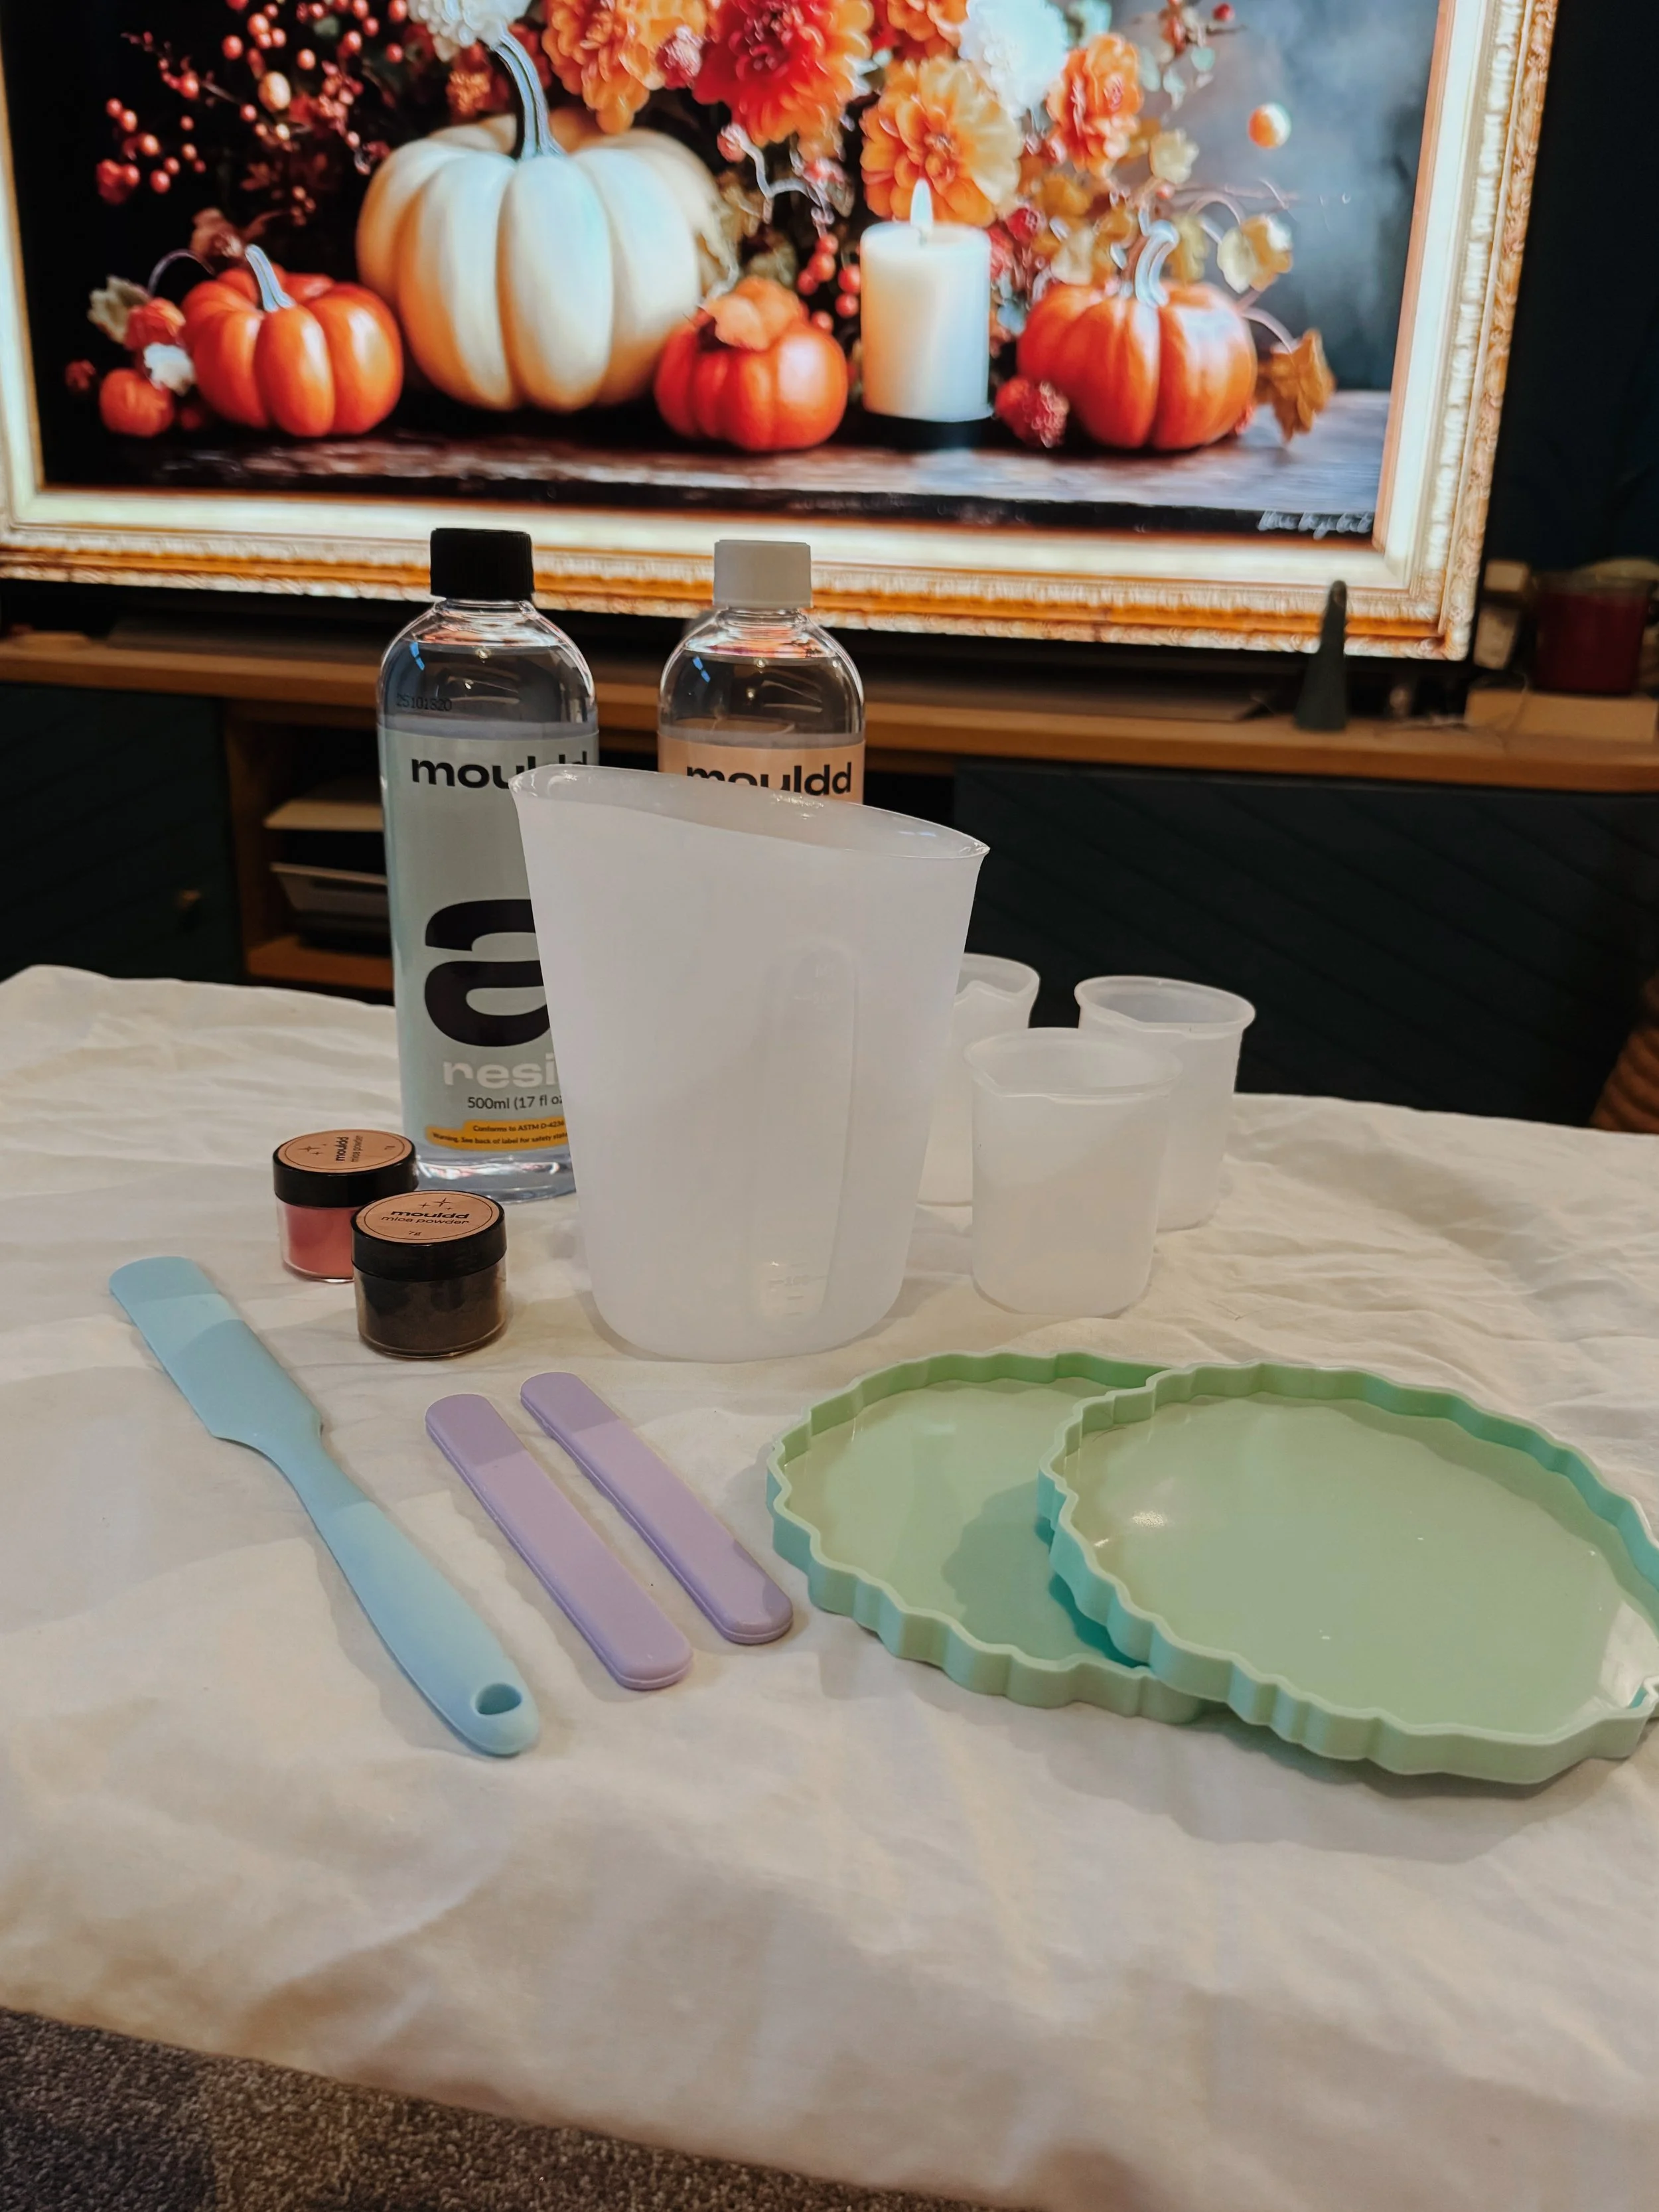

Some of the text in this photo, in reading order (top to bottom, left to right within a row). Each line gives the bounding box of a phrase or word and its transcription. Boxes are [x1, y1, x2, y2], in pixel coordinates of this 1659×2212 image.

[411, 751, 587, 790] mou
[425, 899, 550, 1047] a
[468, 1097, 510, 1109] 500ml
[514, 1096, 535, 1110] (17
[539, 1094, 547, 1106] fl
[334, 1136, 349, 1162] mouldd
